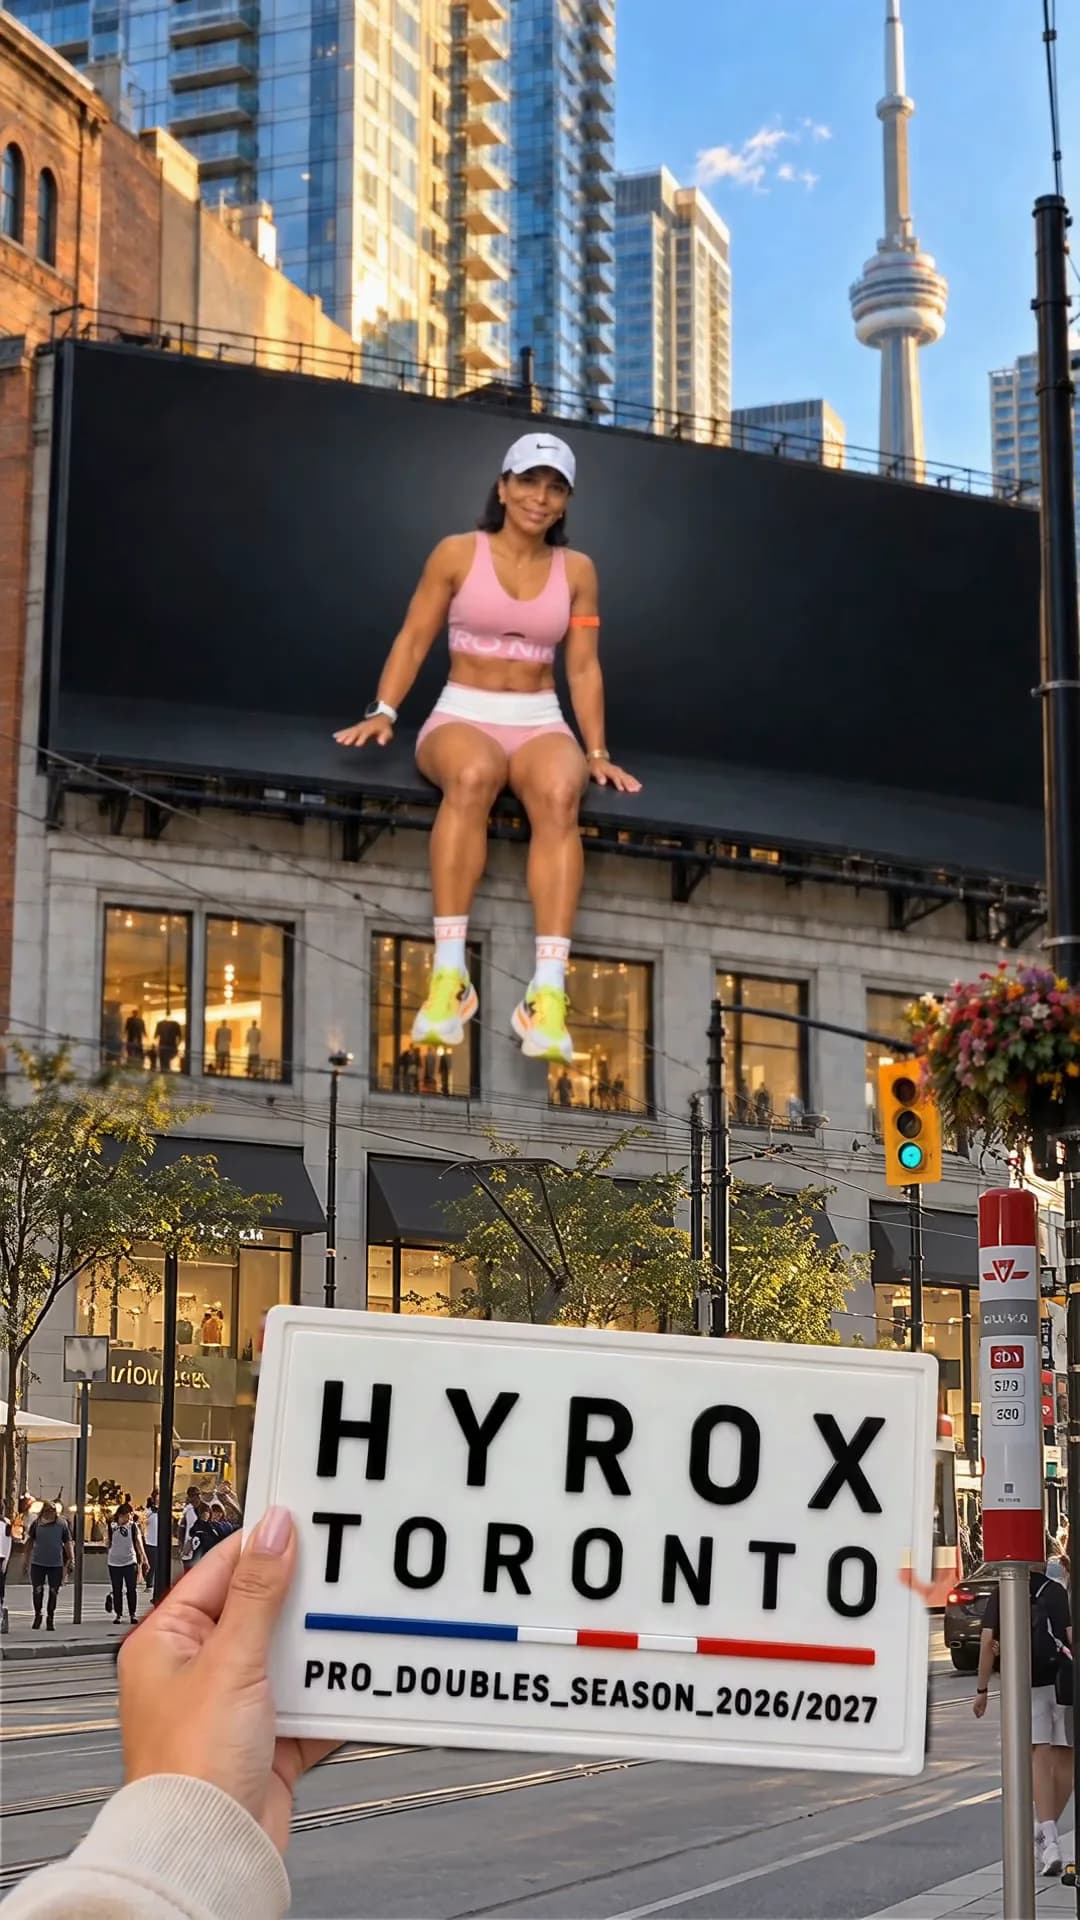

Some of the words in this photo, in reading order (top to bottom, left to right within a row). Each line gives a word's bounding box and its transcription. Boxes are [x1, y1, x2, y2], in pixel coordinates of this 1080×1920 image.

[316, 1380, 886, 1513] HYROX
[312, 1511, 878, 1618] TORONTO
[304, 1660, 878, 1724] PRO_DOUBLES_SEASON_2026/2027
